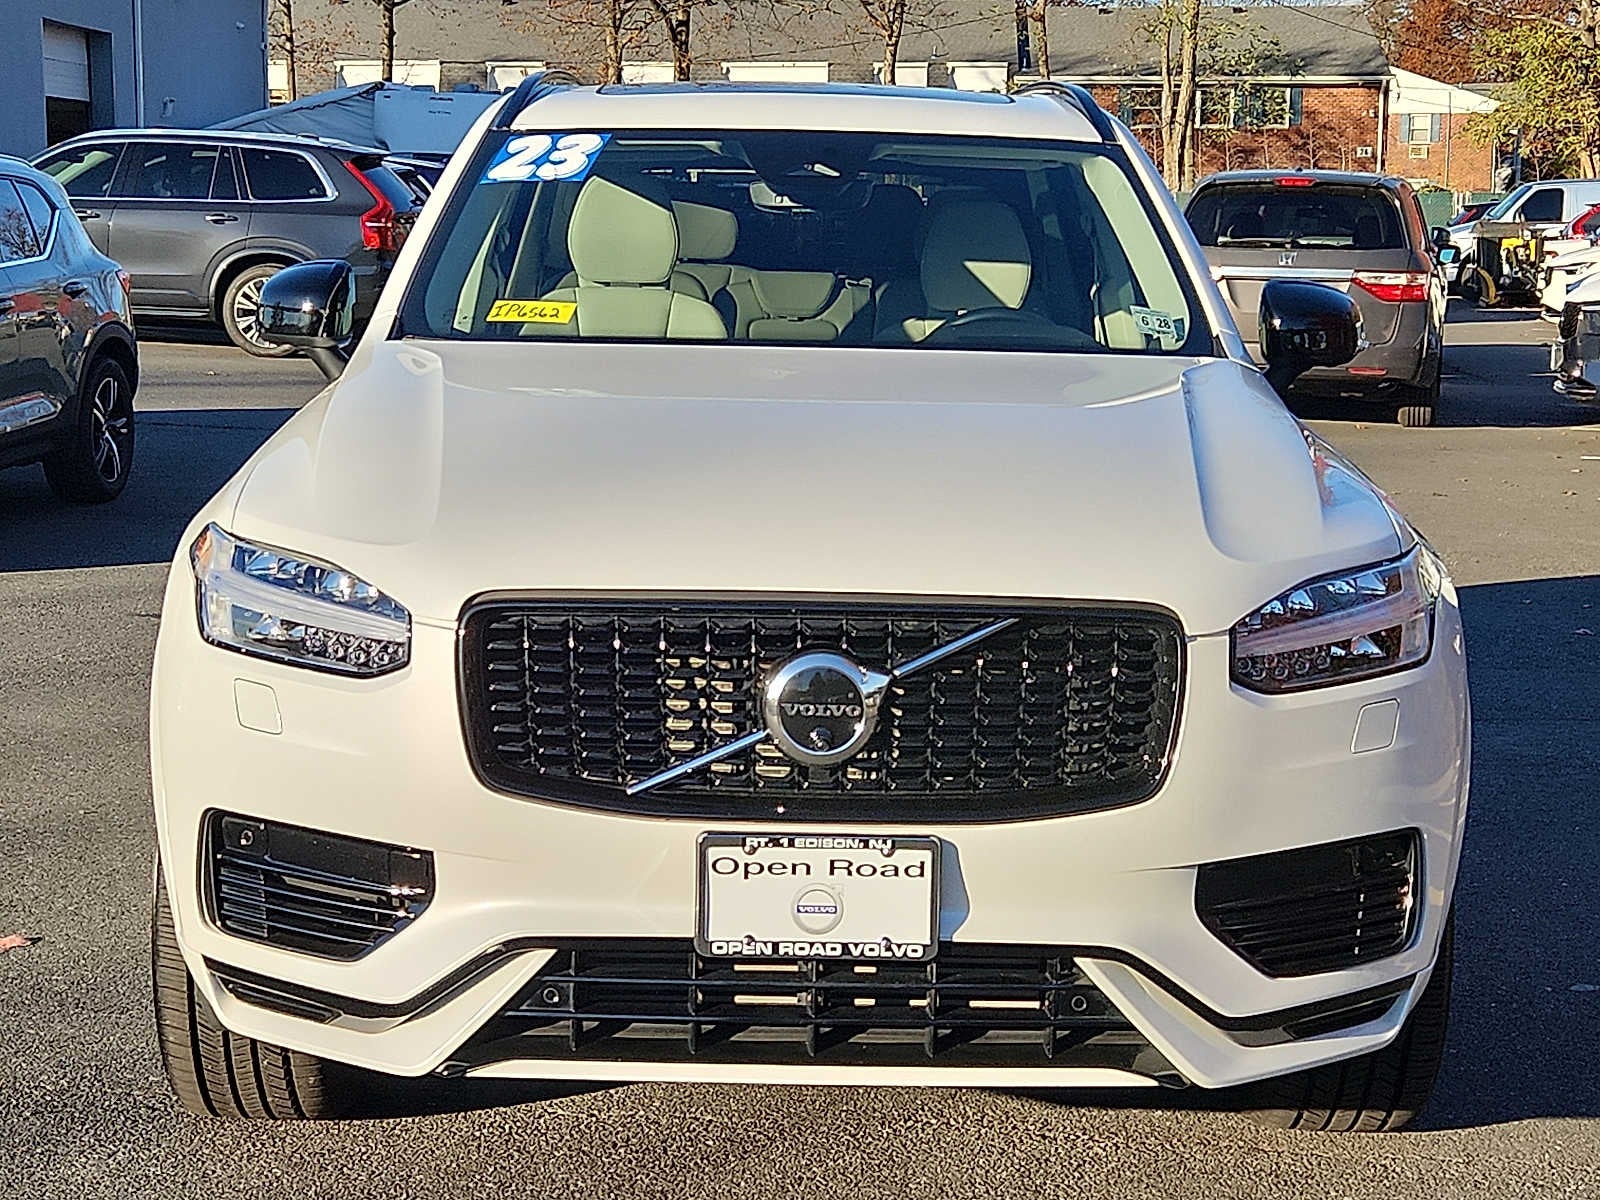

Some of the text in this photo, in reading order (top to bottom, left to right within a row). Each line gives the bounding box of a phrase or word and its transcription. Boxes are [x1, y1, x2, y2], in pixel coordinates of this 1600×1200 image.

[487, 134, 604, 181] 23
[1141, 315, 1171, 330] 6 28
[782, 704, 861, 717] VOLVO
[745, 837, 773, 848] RT.
[780, 838, 789, 848] 1
[868, 839, 892, 850] NJ
[711, 857, 925, 879] Open Road
[711, 941, 924, 958] OPEN ROAD VOLVO
